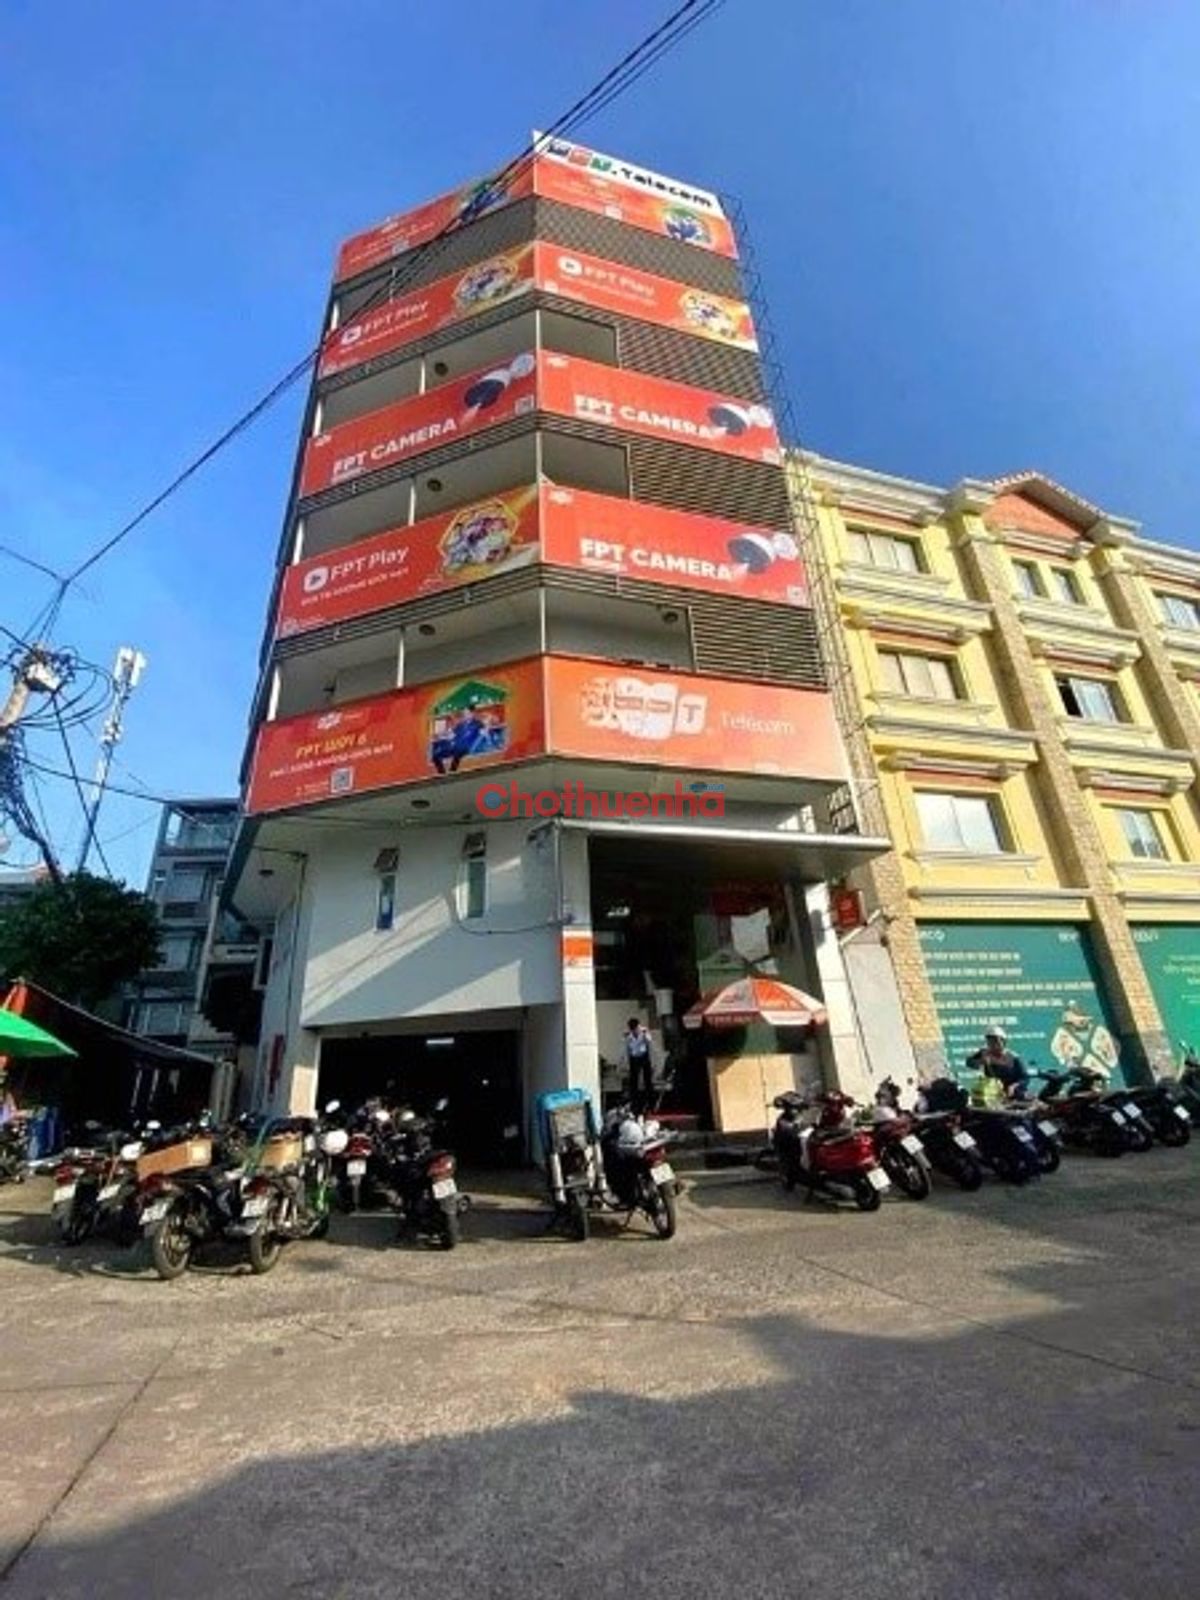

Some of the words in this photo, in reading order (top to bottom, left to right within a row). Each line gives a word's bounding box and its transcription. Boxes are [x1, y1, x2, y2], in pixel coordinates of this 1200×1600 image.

[573, 394, 614, 416] FPT
[618, 405, 714, 439] CAMERA
[332, 450, 367, 477] FPT
[370, 418, 458, 461] CAMERA
[330, 557, 367, 580] FPT
[367, 546, 410, 568] Play
[579, 537, 626, 563] FPT
[630, 547, 734, 581] CAMERA
[719, 711, 796, 737] Telecom
